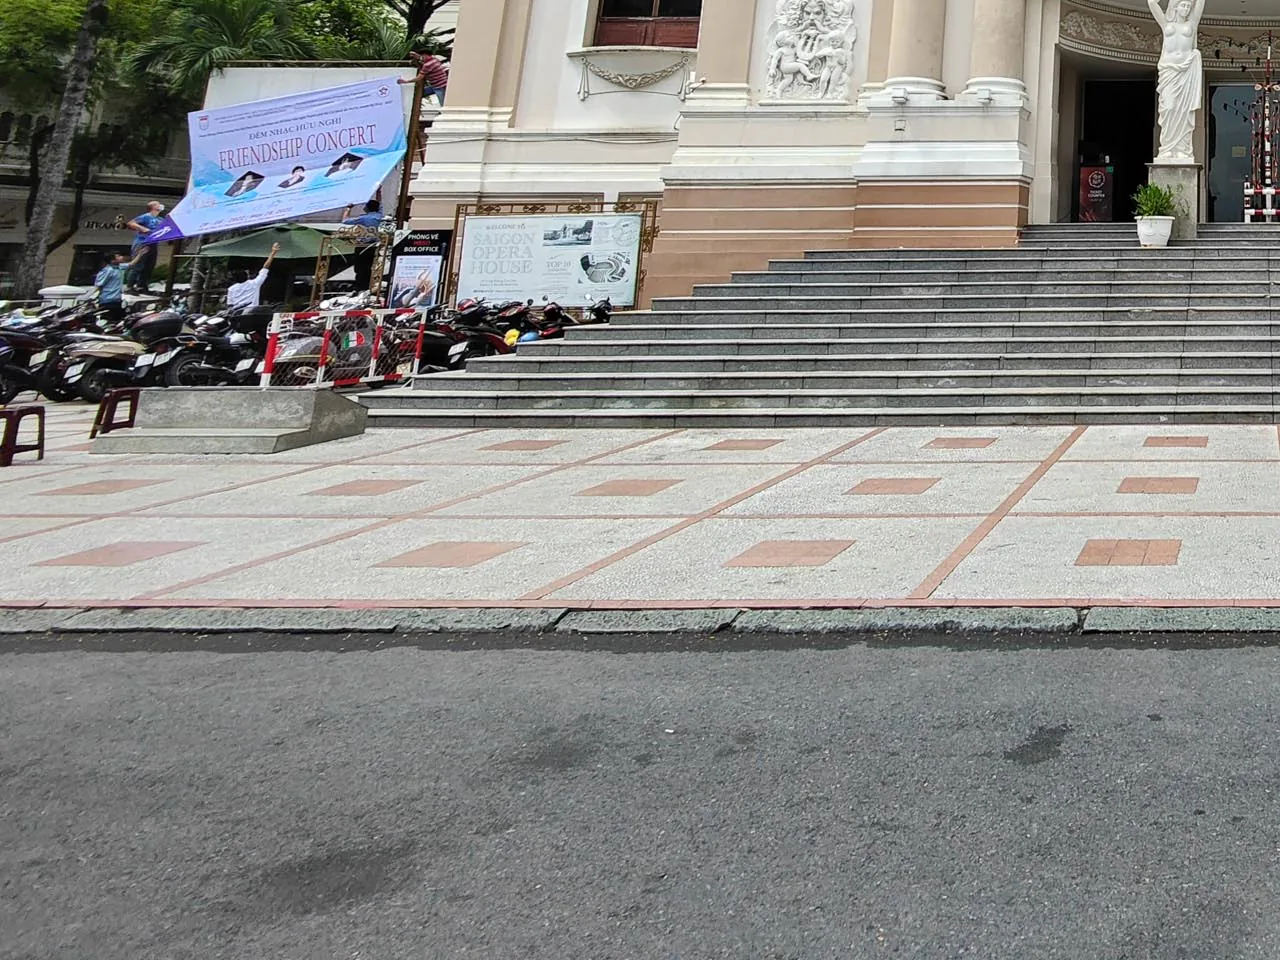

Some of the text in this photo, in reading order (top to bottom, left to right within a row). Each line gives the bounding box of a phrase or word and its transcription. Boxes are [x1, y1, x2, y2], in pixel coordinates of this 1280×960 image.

[218, 124, 376, 170] FRIENDSHIP CONCERT
[472, 232, 536, 246] SAIGON
[471, 245, 533, 260] OPERA
[470, 259, 533, 275] HOUSE
